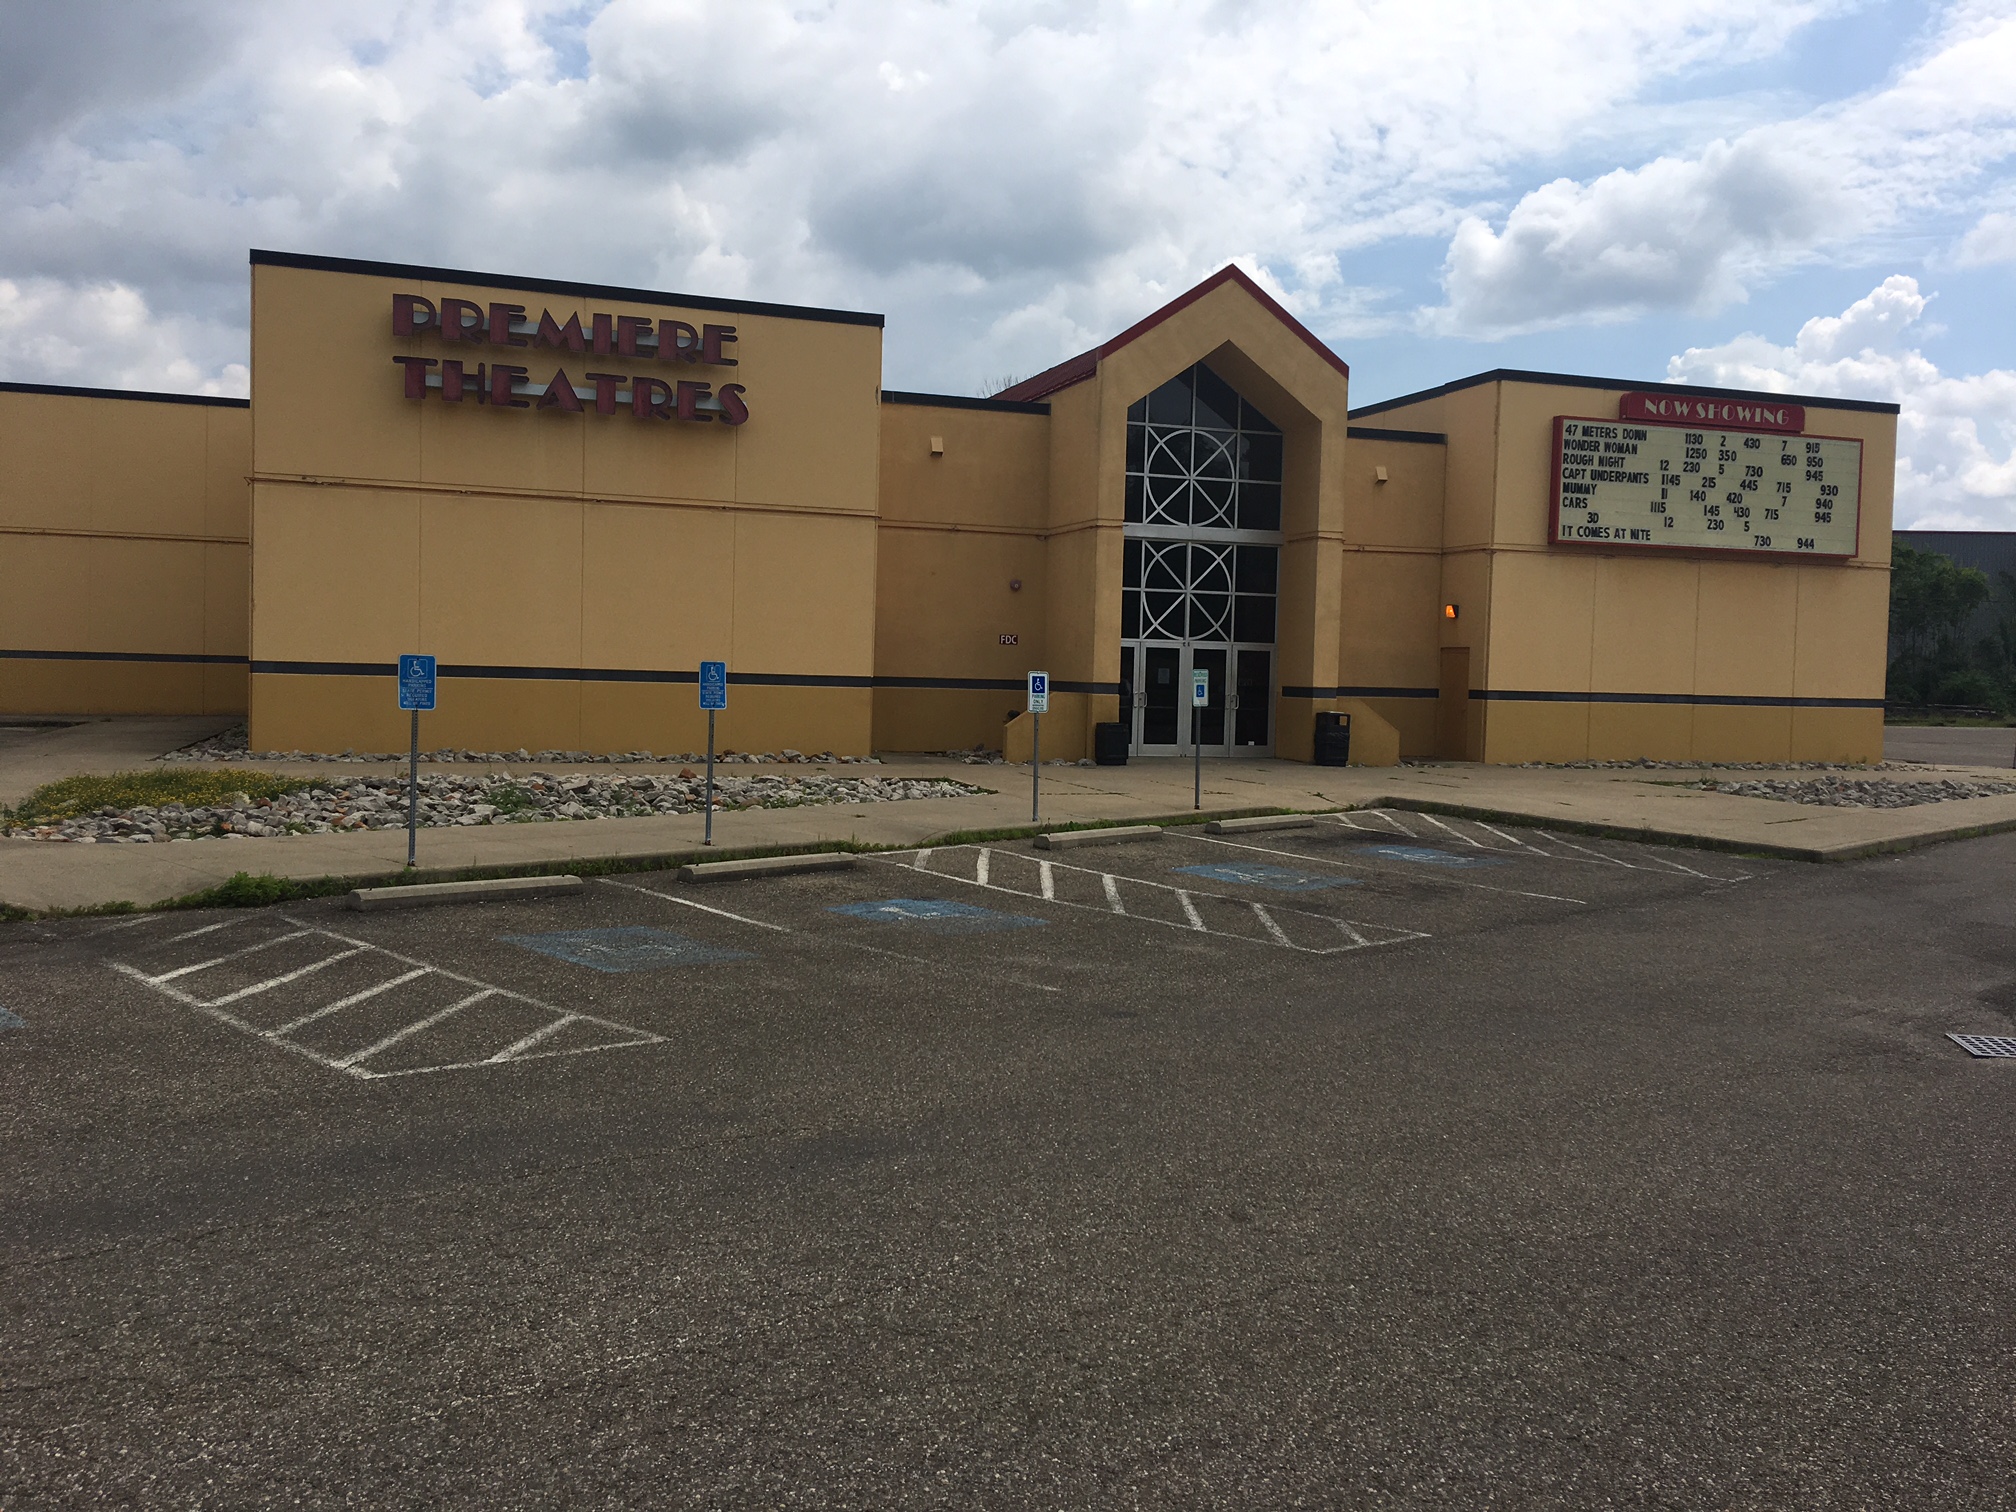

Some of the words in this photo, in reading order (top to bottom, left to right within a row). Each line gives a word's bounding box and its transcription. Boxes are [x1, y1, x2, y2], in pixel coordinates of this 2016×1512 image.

[393, 294, 739, 366] PREMIERE
[393, 356, 749, 426] THEATRES
[1645, 399, 1692, 417] NOW
[1696, 403, 1789, 425] SHOWING
[1565, 424, 1578, 436] 47
[1582, 426, 1618, 439] METERS
[1623, 428, 1647, 441] DOWN
[1685, 433, 1703, 445] 1130
[1721, 436, 1726, 447] 2
[1744, 438, 1760, 449] 430
[1782, 441, 1787, 451] 7
[1806, 442, 1820, 454] 915
[1563, 453, 1594, 466] ROUGH
[1598, 456, 1626, 468] NIGHT
[1660, 460, 1669, 471] 12
[1683, 462, 1700, 473] 230
[1719, 464, 1724, 475] 5
[1745, 466, 1763, 477] 730
[1806, 470, 1823, 481] 945
[1564, 439, 1600, 453] WONDER
[1604, 442, 1638, 455] WOMAN
[1686, 447, 1707, 459] 1250
[1718, 450, 1737, 461] 350
[1781, 454, 1797, 466] 650
[1806, 457, 1823, 468] 950
[1562, 467, 1587, 479] CAPT
[1590, 469, 1649, 484] UNDERPANTS
[1662, 474, 1681, 486] 1145
[1702, 477, 1716, 488] 215
[1740, 480, 1758, 491] 445
[1777, 482, 1791, 493] 715
[1820, 485, 1838, 496] 930
[1562, 497, 1588, 508] CARS
[1650, 502, 1666, 513] 1115
[1704, 505, 1720, 516] 145
[1734, 507, 1750, 518] 430
[1765, 509, 1779, 520] 715
[1815, 512, 1832, 523] 945
[1563, 482, 1597, 495] MUMMY
[1690, 490, 1706, 501] 140
[1727, 493, 1743, 504] 420
[1782, 496, 1787, 507] 7
[1816, 498, 1833, 510] 940
[1587, 512, 1599, 524] 3D
[1664, 517, 1674, 528] 12
[1707, 519, 1724, 530] 230
[1744, 521, 1750, 532] 5
[1562, 525, 1573, 537] IT
[1577, 526, 1610, 538] COMES
[1614, 528, 1627, 539] AT
[1630, 529, 1651, 540] NITE
[1754, 536, 1772, 547] 730
[1797, 538, 1815, 549] 944
[1000, 635, 1017, 645] FDC
